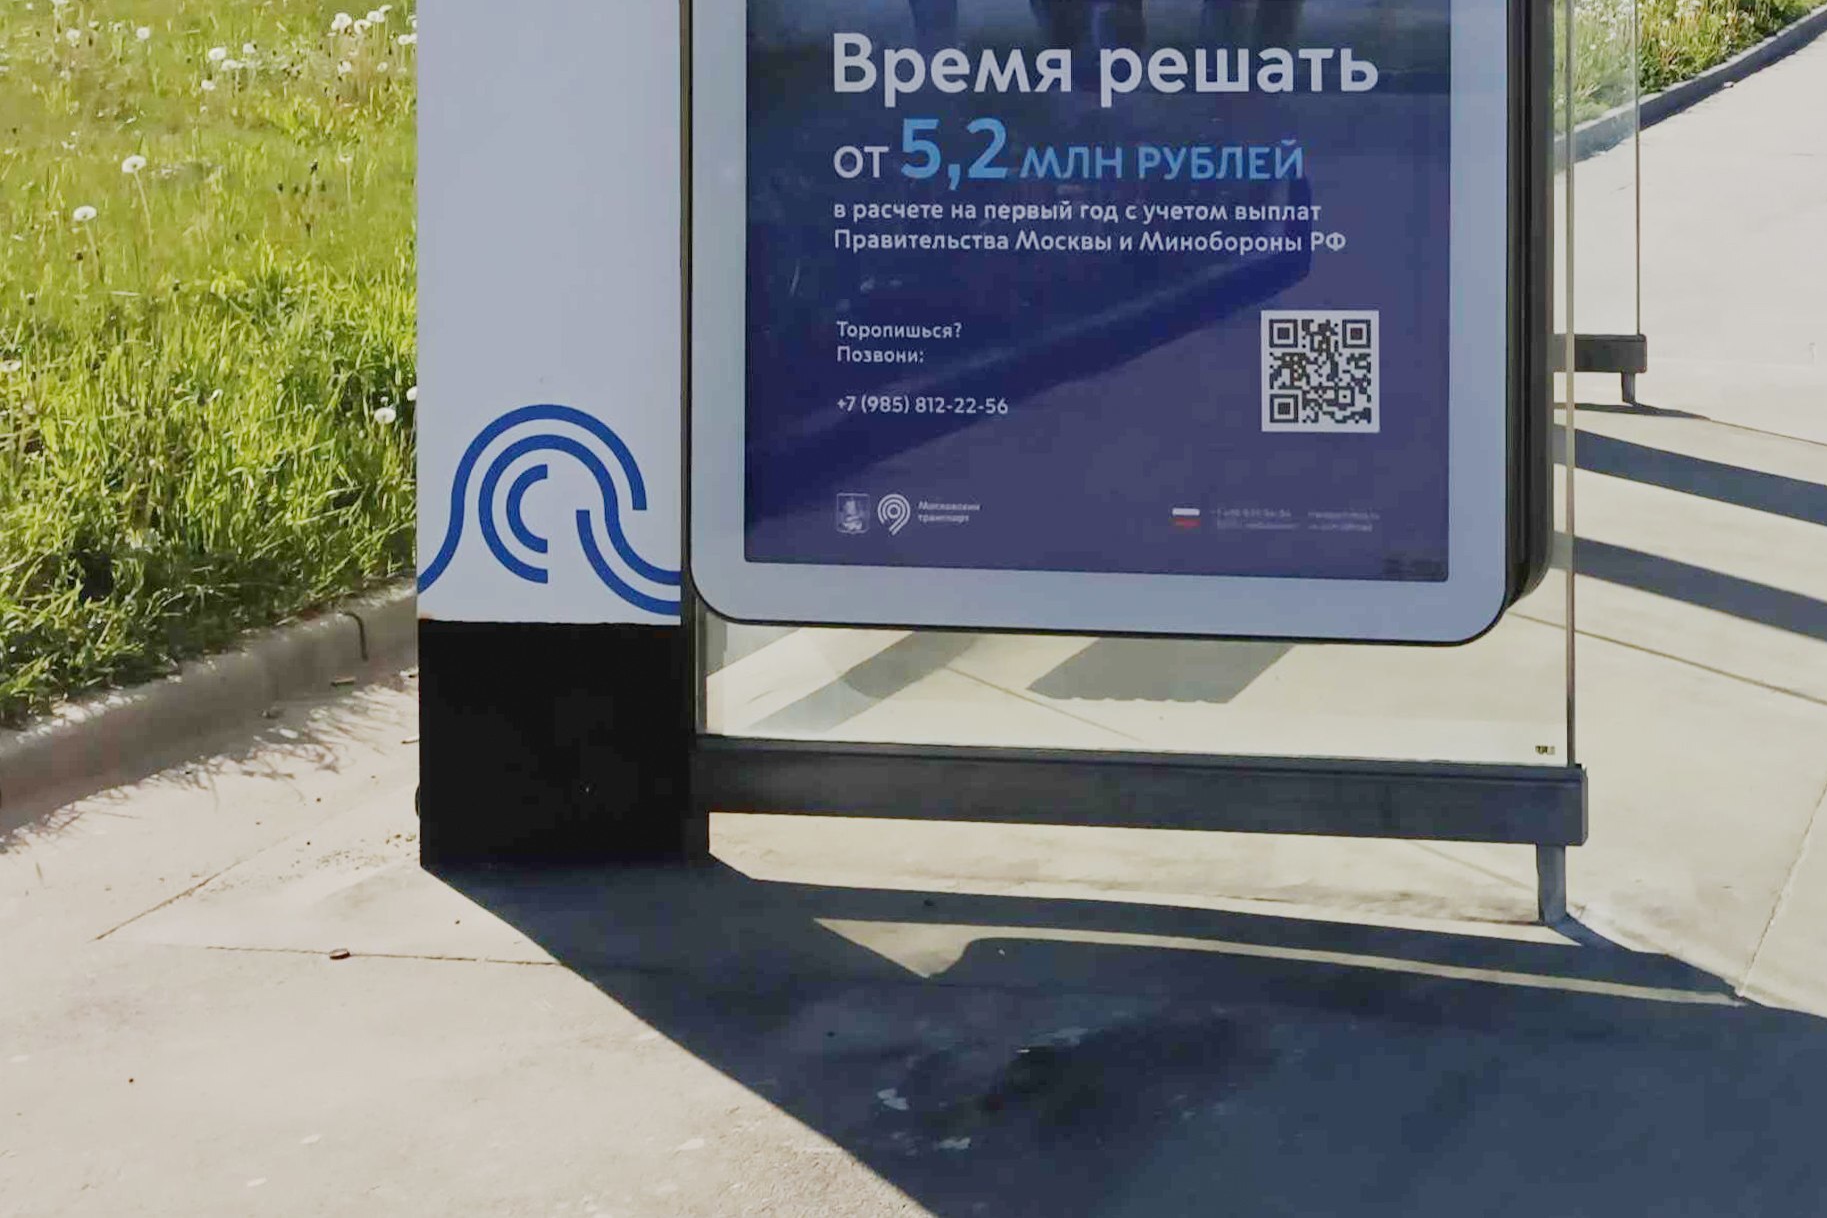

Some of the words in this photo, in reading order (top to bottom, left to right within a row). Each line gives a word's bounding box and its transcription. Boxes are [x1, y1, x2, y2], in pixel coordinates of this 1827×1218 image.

[834, 33, 1071, 107] Время
[1100, 48, 1378, 108] решать
[901, 118, 1008, 190] 5,2
[1139, 139, 1303, 179] РУБЛЕЙ
[835, 204, 846, 218] в
[854, 204, 943, 222] расчете
[952, 205, 976, 218] на
[985, 201, 1072, 223] первый
[1081, 205, 1118, 223] год
[1126, 206, 1137, 219] с
[1143, 205, 1227, 224] учетом
[1236, 206, 1321, 220] выплат
[835, 229, 1008, 252] Правительства
[1016, 231, 1111, 250] Москвы
[1120, 236, 1132, 250] и
[1140, 231, 1301, 255] Минобороны
[1311, 232, 1346, 251] РФ
[837, 321, 961, 340] Торопишься?
[837, 346, 923, 362] Позвони:
[838, 396, 856, 411] +7
[862, 395, 909, 413] (985)
[915, 397, 1008, 414] 812-22-56
